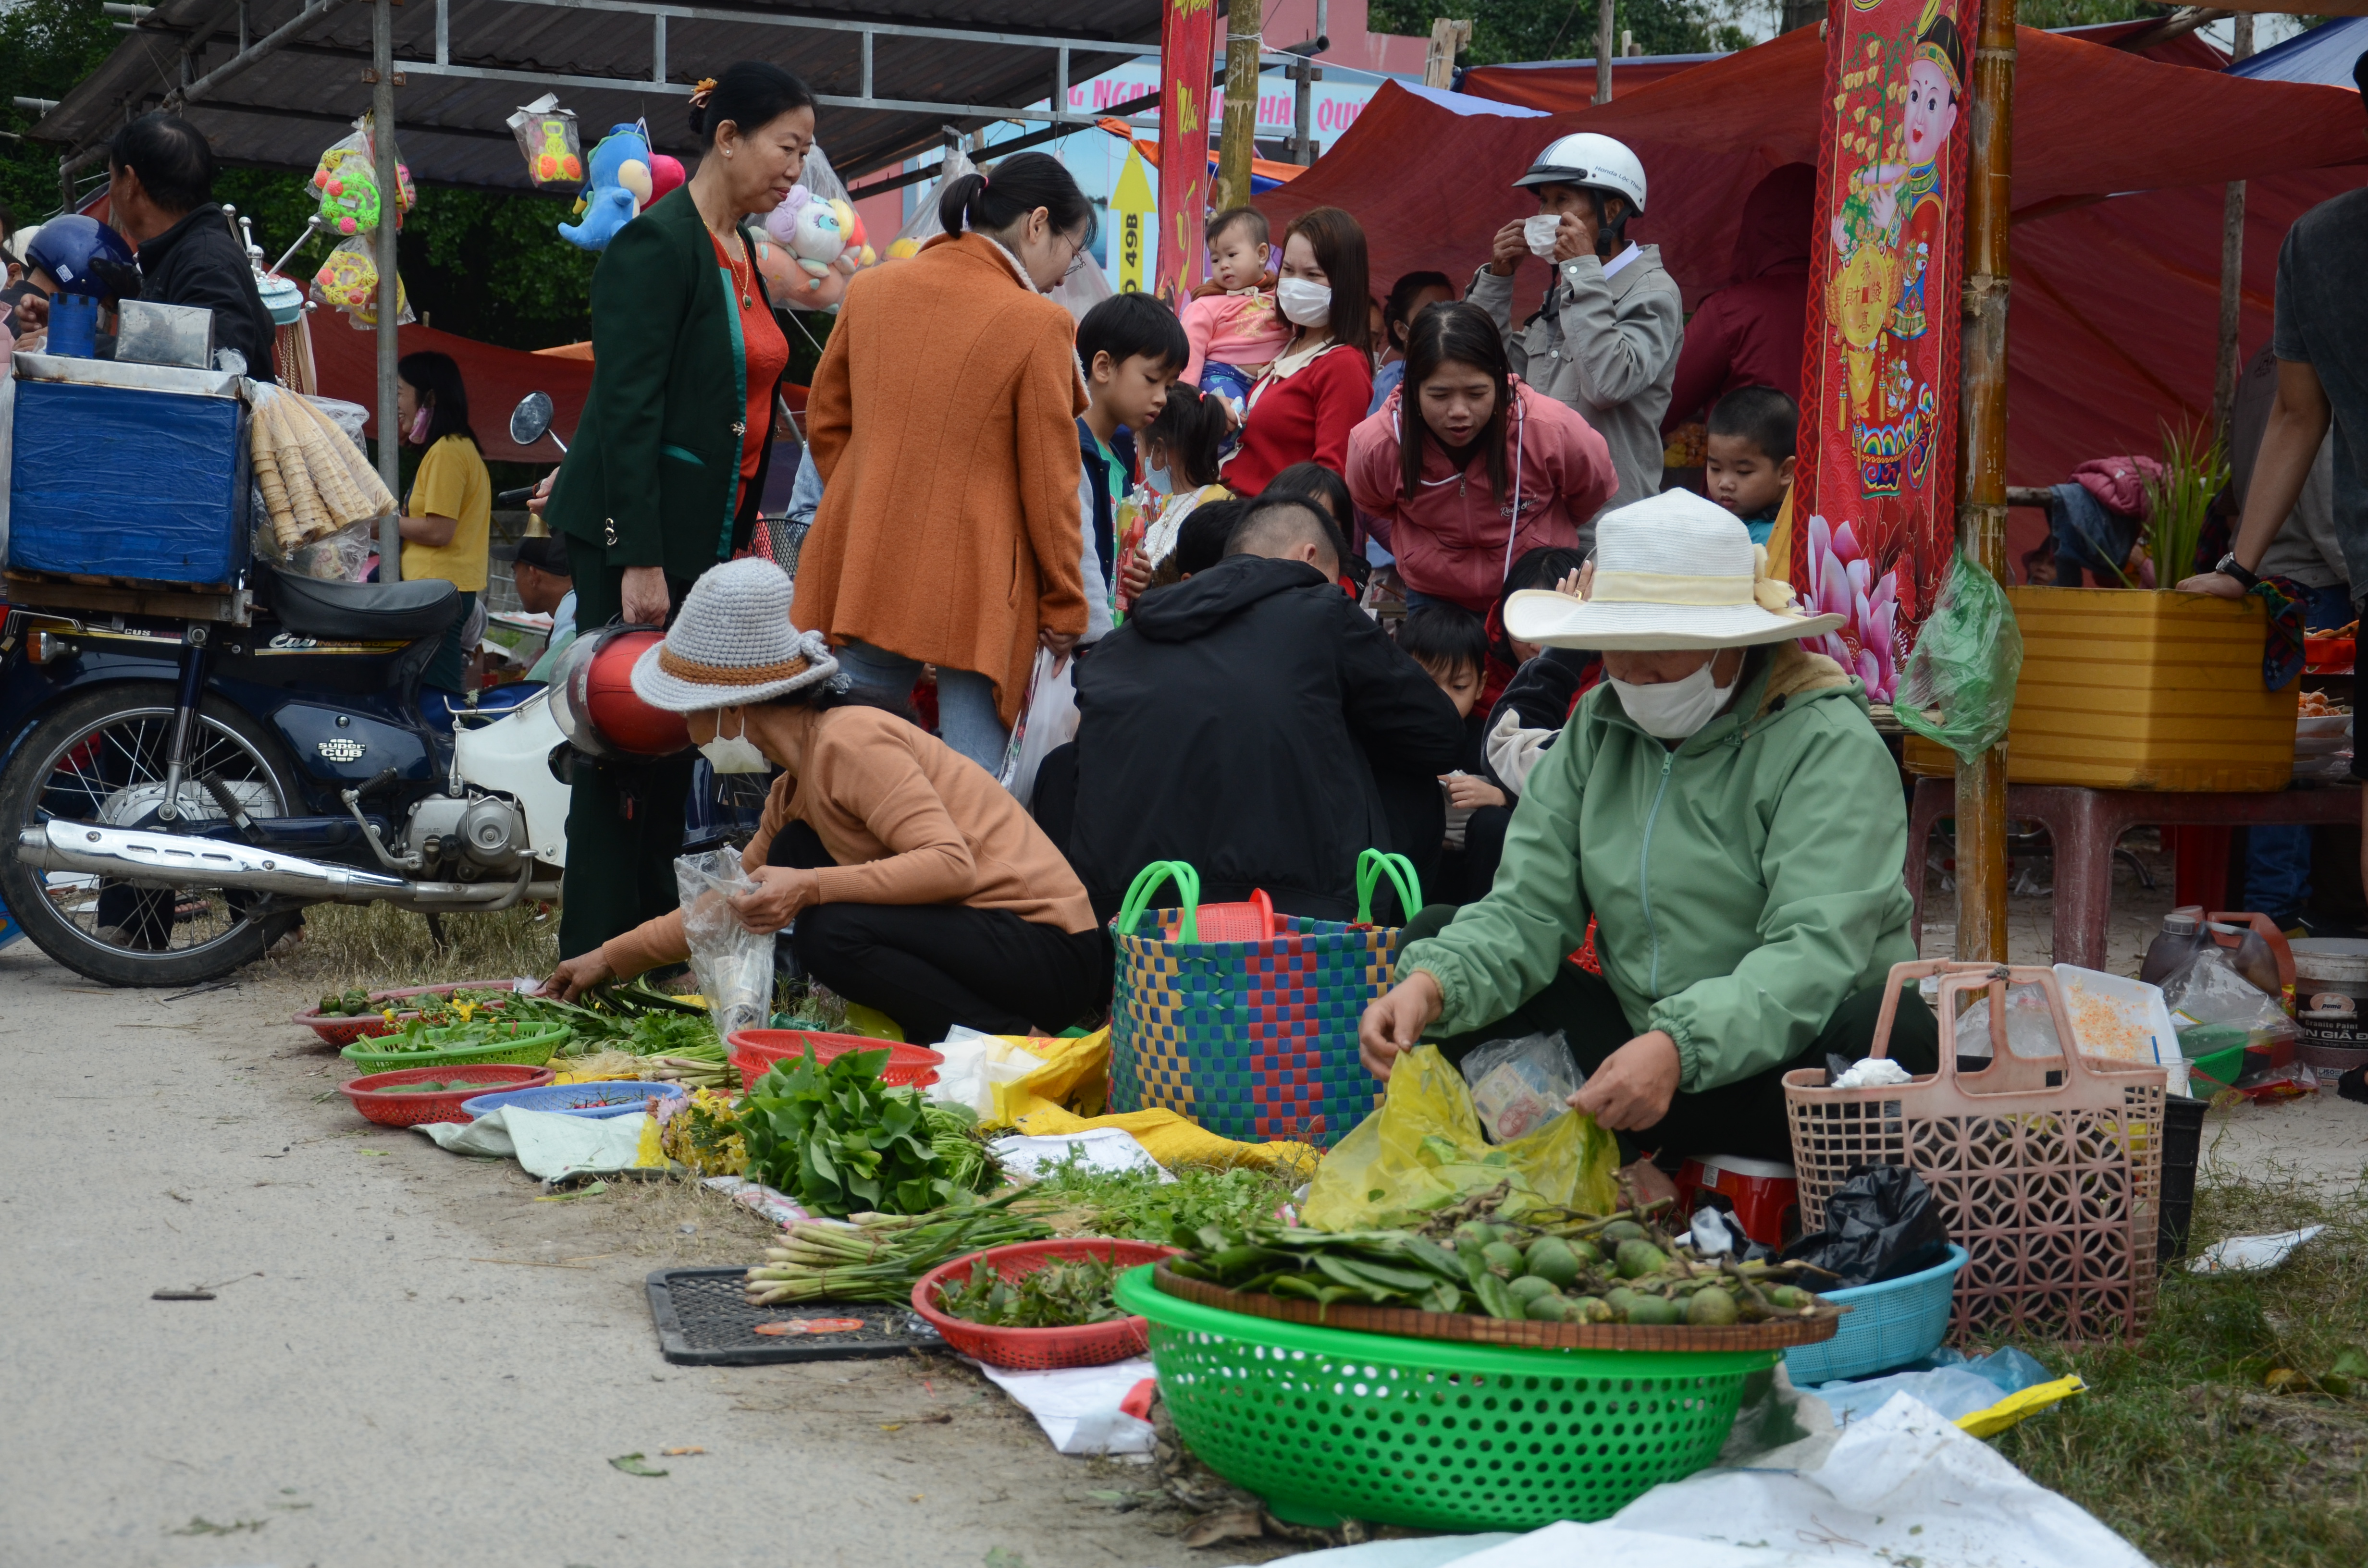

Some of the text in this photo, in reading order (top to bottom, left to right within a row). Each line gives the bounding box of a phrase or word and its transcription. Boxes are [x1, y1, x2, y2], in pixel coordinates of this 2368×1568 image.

[1595, 166, 1617, 176] Honda
[1125, 213, 1137, 268] 49B
[321, 749, 362, 757] CUB
[2305, 1019, 2333, 1028] Granite
[2321, 1029, 2352, 1040] GIẢ
